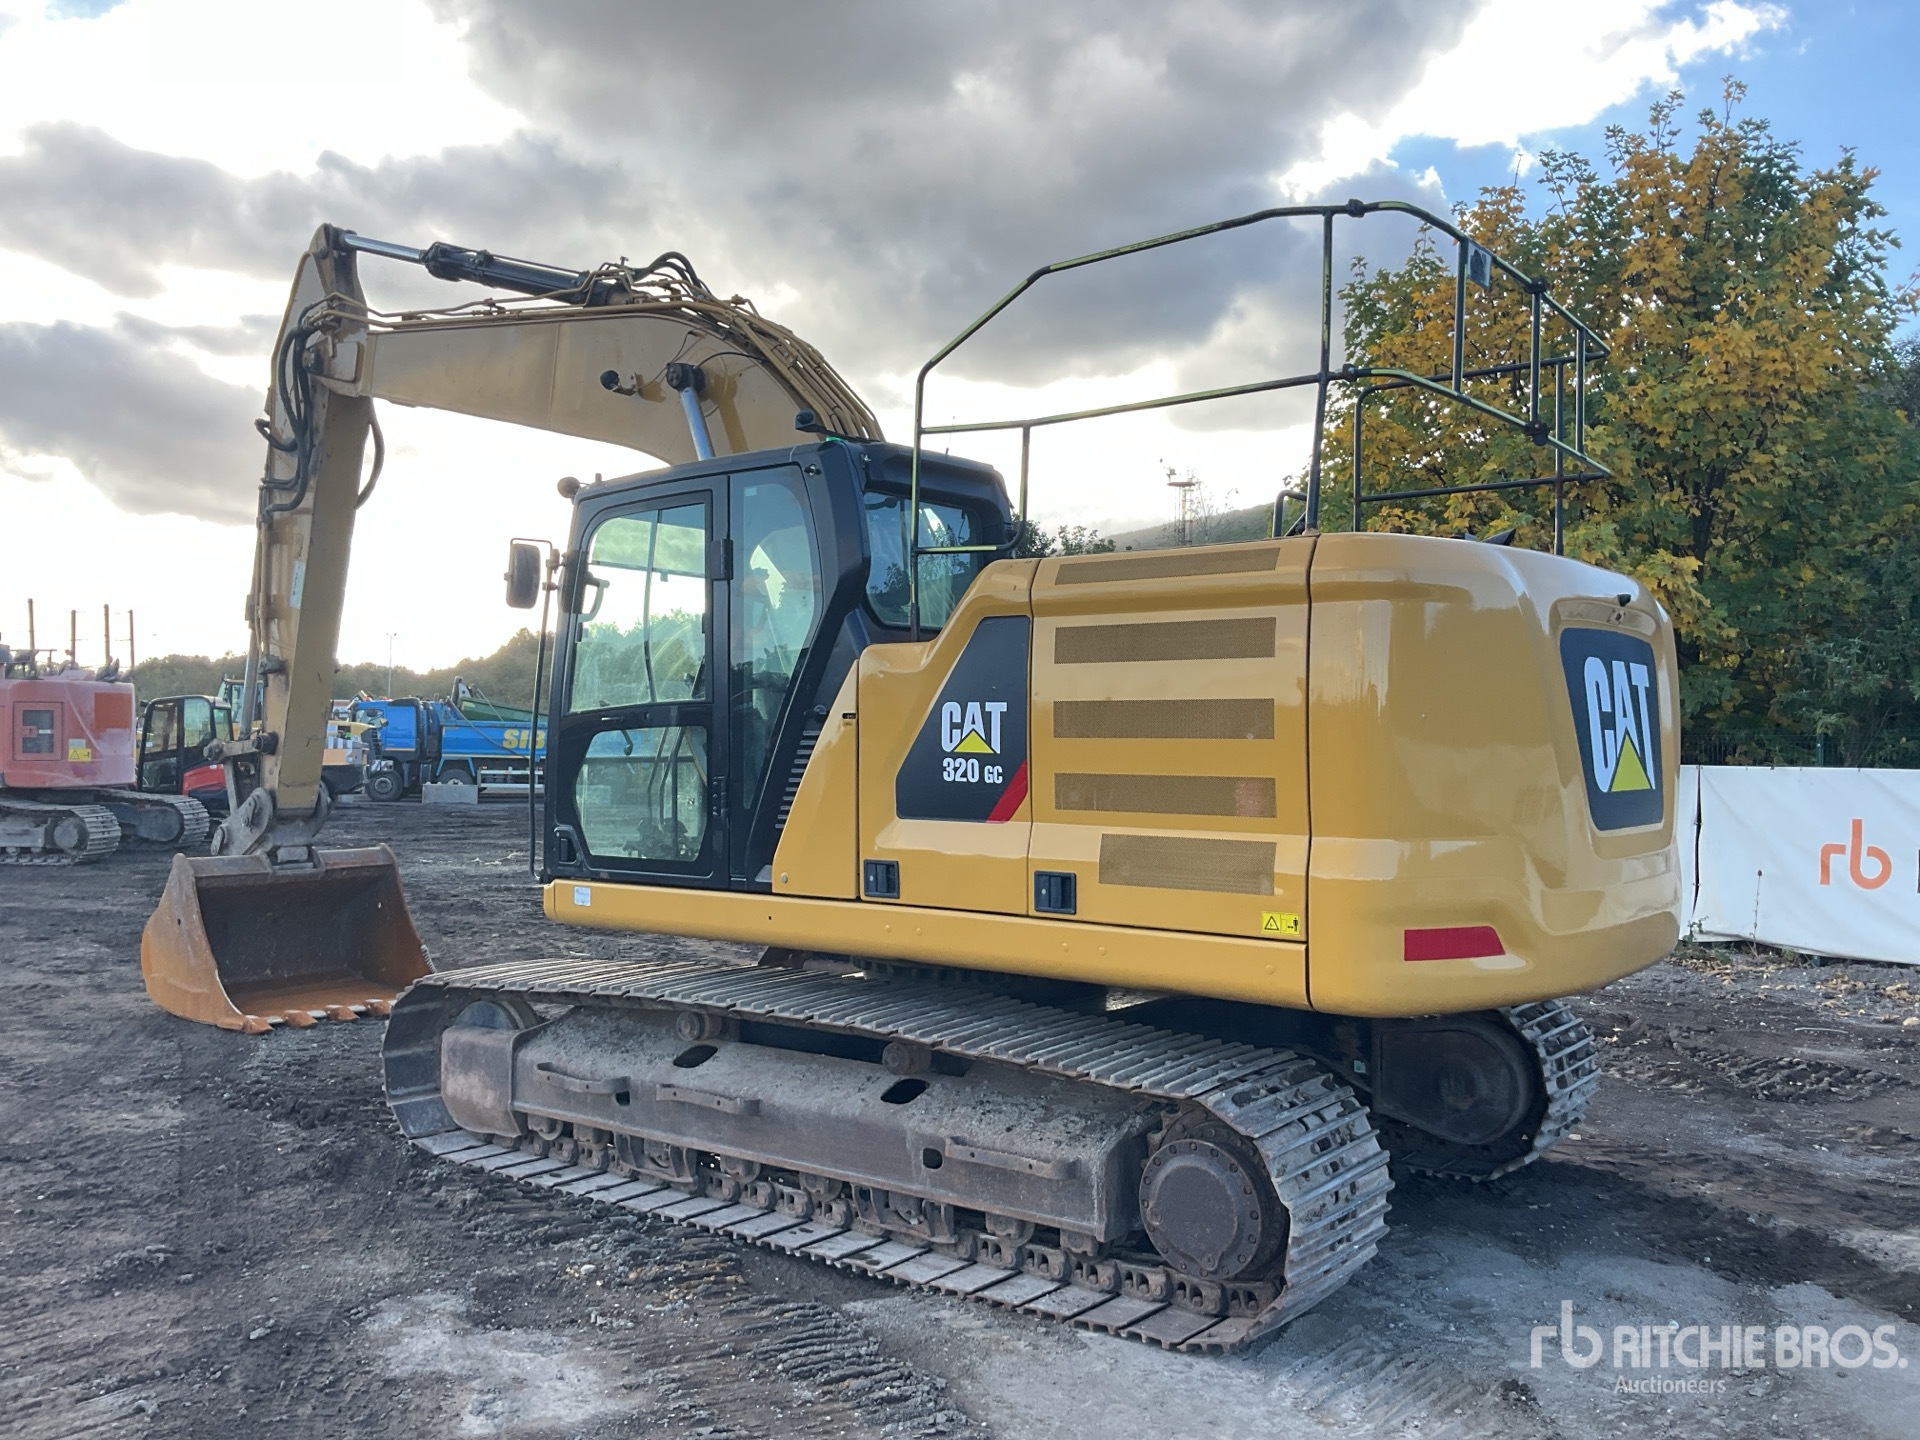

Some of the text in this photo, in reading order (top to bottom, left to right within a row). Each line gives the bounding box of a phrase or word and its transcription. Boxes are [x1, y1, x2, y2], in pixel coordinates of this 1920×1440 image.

[941, 701, 1008, 754] CAT
[1583, 656, 1656, 793] CAT
[942, 757, 1003, 784] 320 GC
[1820, 818, 1893, 890] rb
